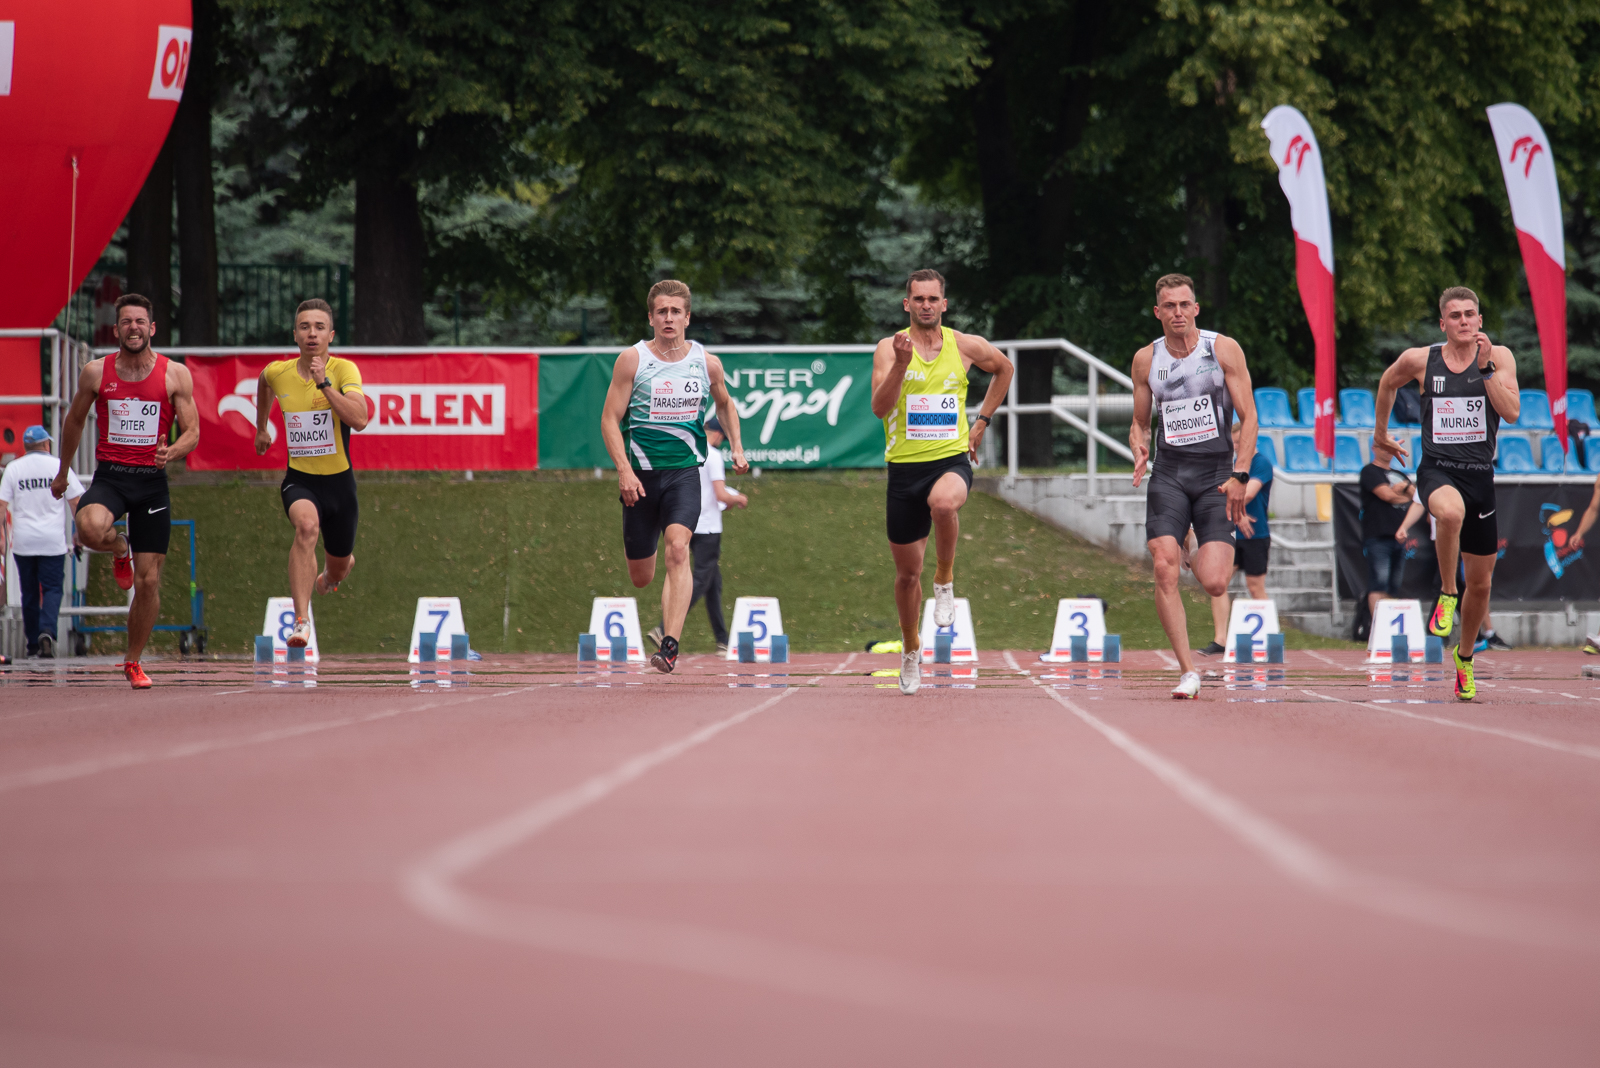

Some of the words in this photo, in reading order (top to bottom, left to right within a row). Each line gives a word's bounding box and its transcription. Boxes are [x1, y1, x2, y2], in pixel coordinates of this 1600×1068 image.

[723, 368, 813, 388] NTER
[684, 382, 699, 393] 63
[653, 398, 699, 408] TARASIEWICZ
[941, 398, 956, 409] 68
[1193, 398, 1209, 412] 69
[1466, 400, 1482, 412] 59
[141, 404, 158, 416] 60
[120, 420, 145, 431] PITER
[312, 413, 328, 426] 57
[909, 414, 956, 425] CHOCHOROWSKI
[1166, 414, 1214, 432] HORBOWICZ
[1440, 417, 1479, 428] MURIAS
[290, 430, 328, 442] DONACKI
[110, 464, 134, 474] NIKE
[1436, 460, 1466, 469] NIKE
[428, 610, 450, 636] 7
[604, 611, 625, 643] 6
[747, 610, 768, 642] 5
[1390, 613, 1405, 635] 1
[1243, 613, 1264, 646] 2
